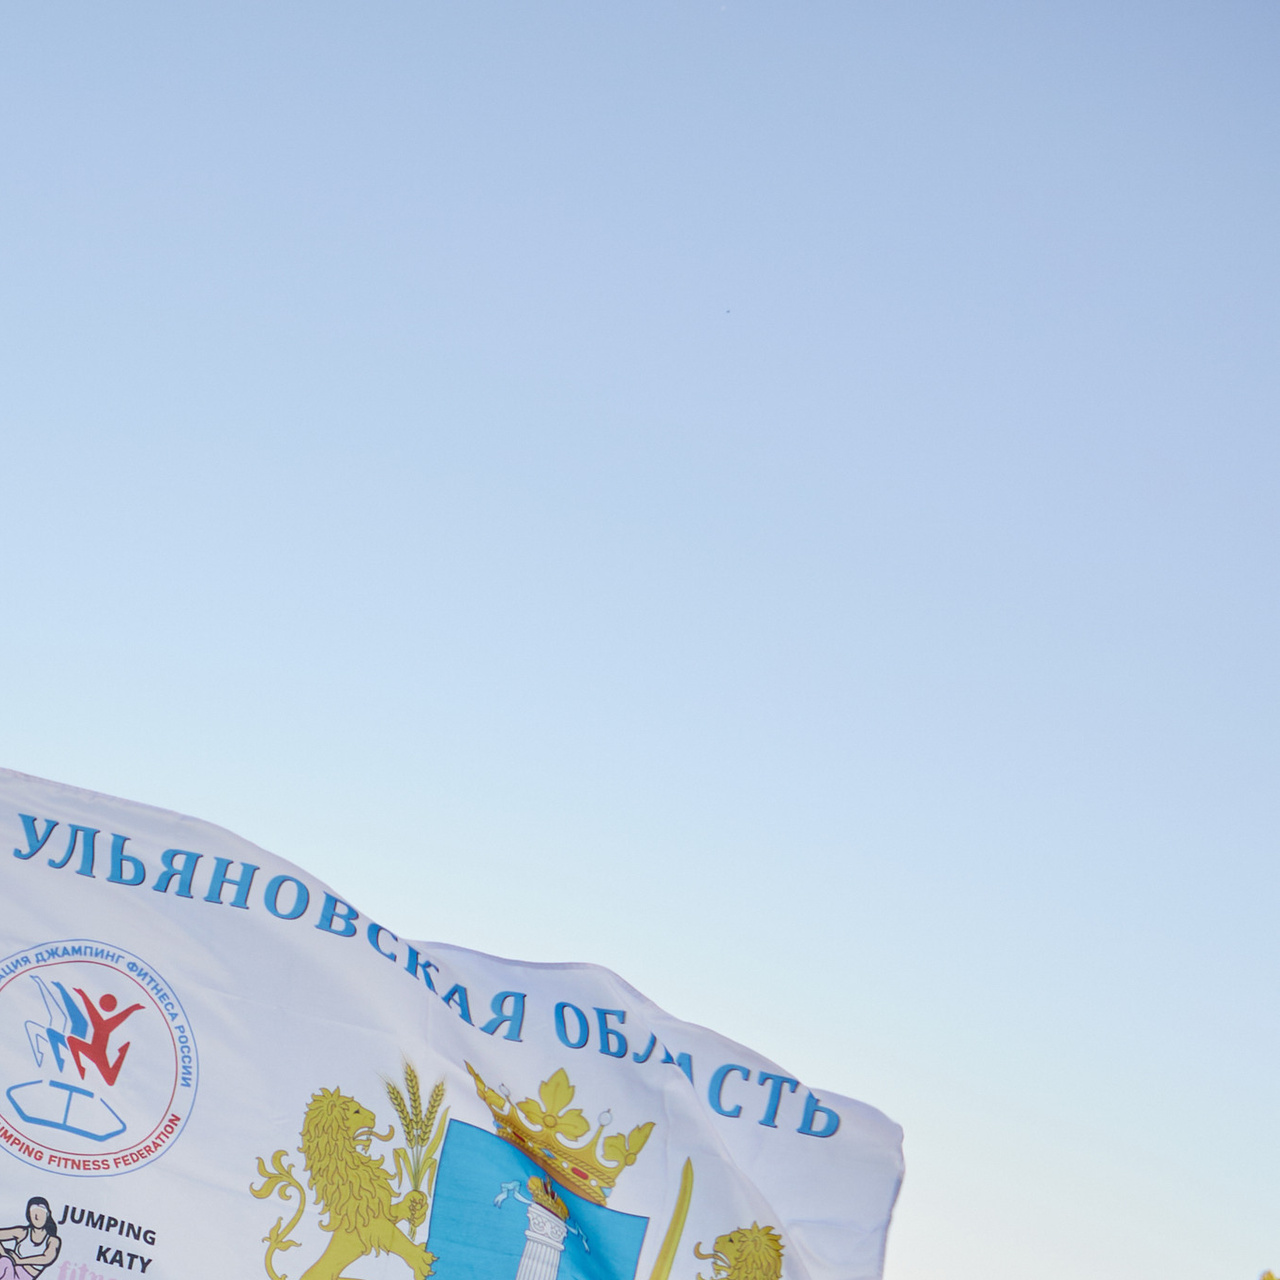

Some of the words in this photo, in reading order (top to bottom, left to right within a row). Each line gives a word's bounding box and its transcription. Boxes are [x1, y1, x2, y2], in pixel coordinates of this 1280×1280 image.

[12, 812, 528, 1043] УЛЬЯНОВСКАЯ
[34, 945, 125, 965] ДЖАМПИНГ
[126, 961, 179, 1022] ФИТНЕСА
[174, 1025, 193, 1089] РОССИИ
[47, 1154, 111, 1171] FITNESS
[113, 1113, 182, 1169] FEDERATION
[58, 1204, 158, 1246] JUMPING
[95, 1245, 153, 1274] KATY
